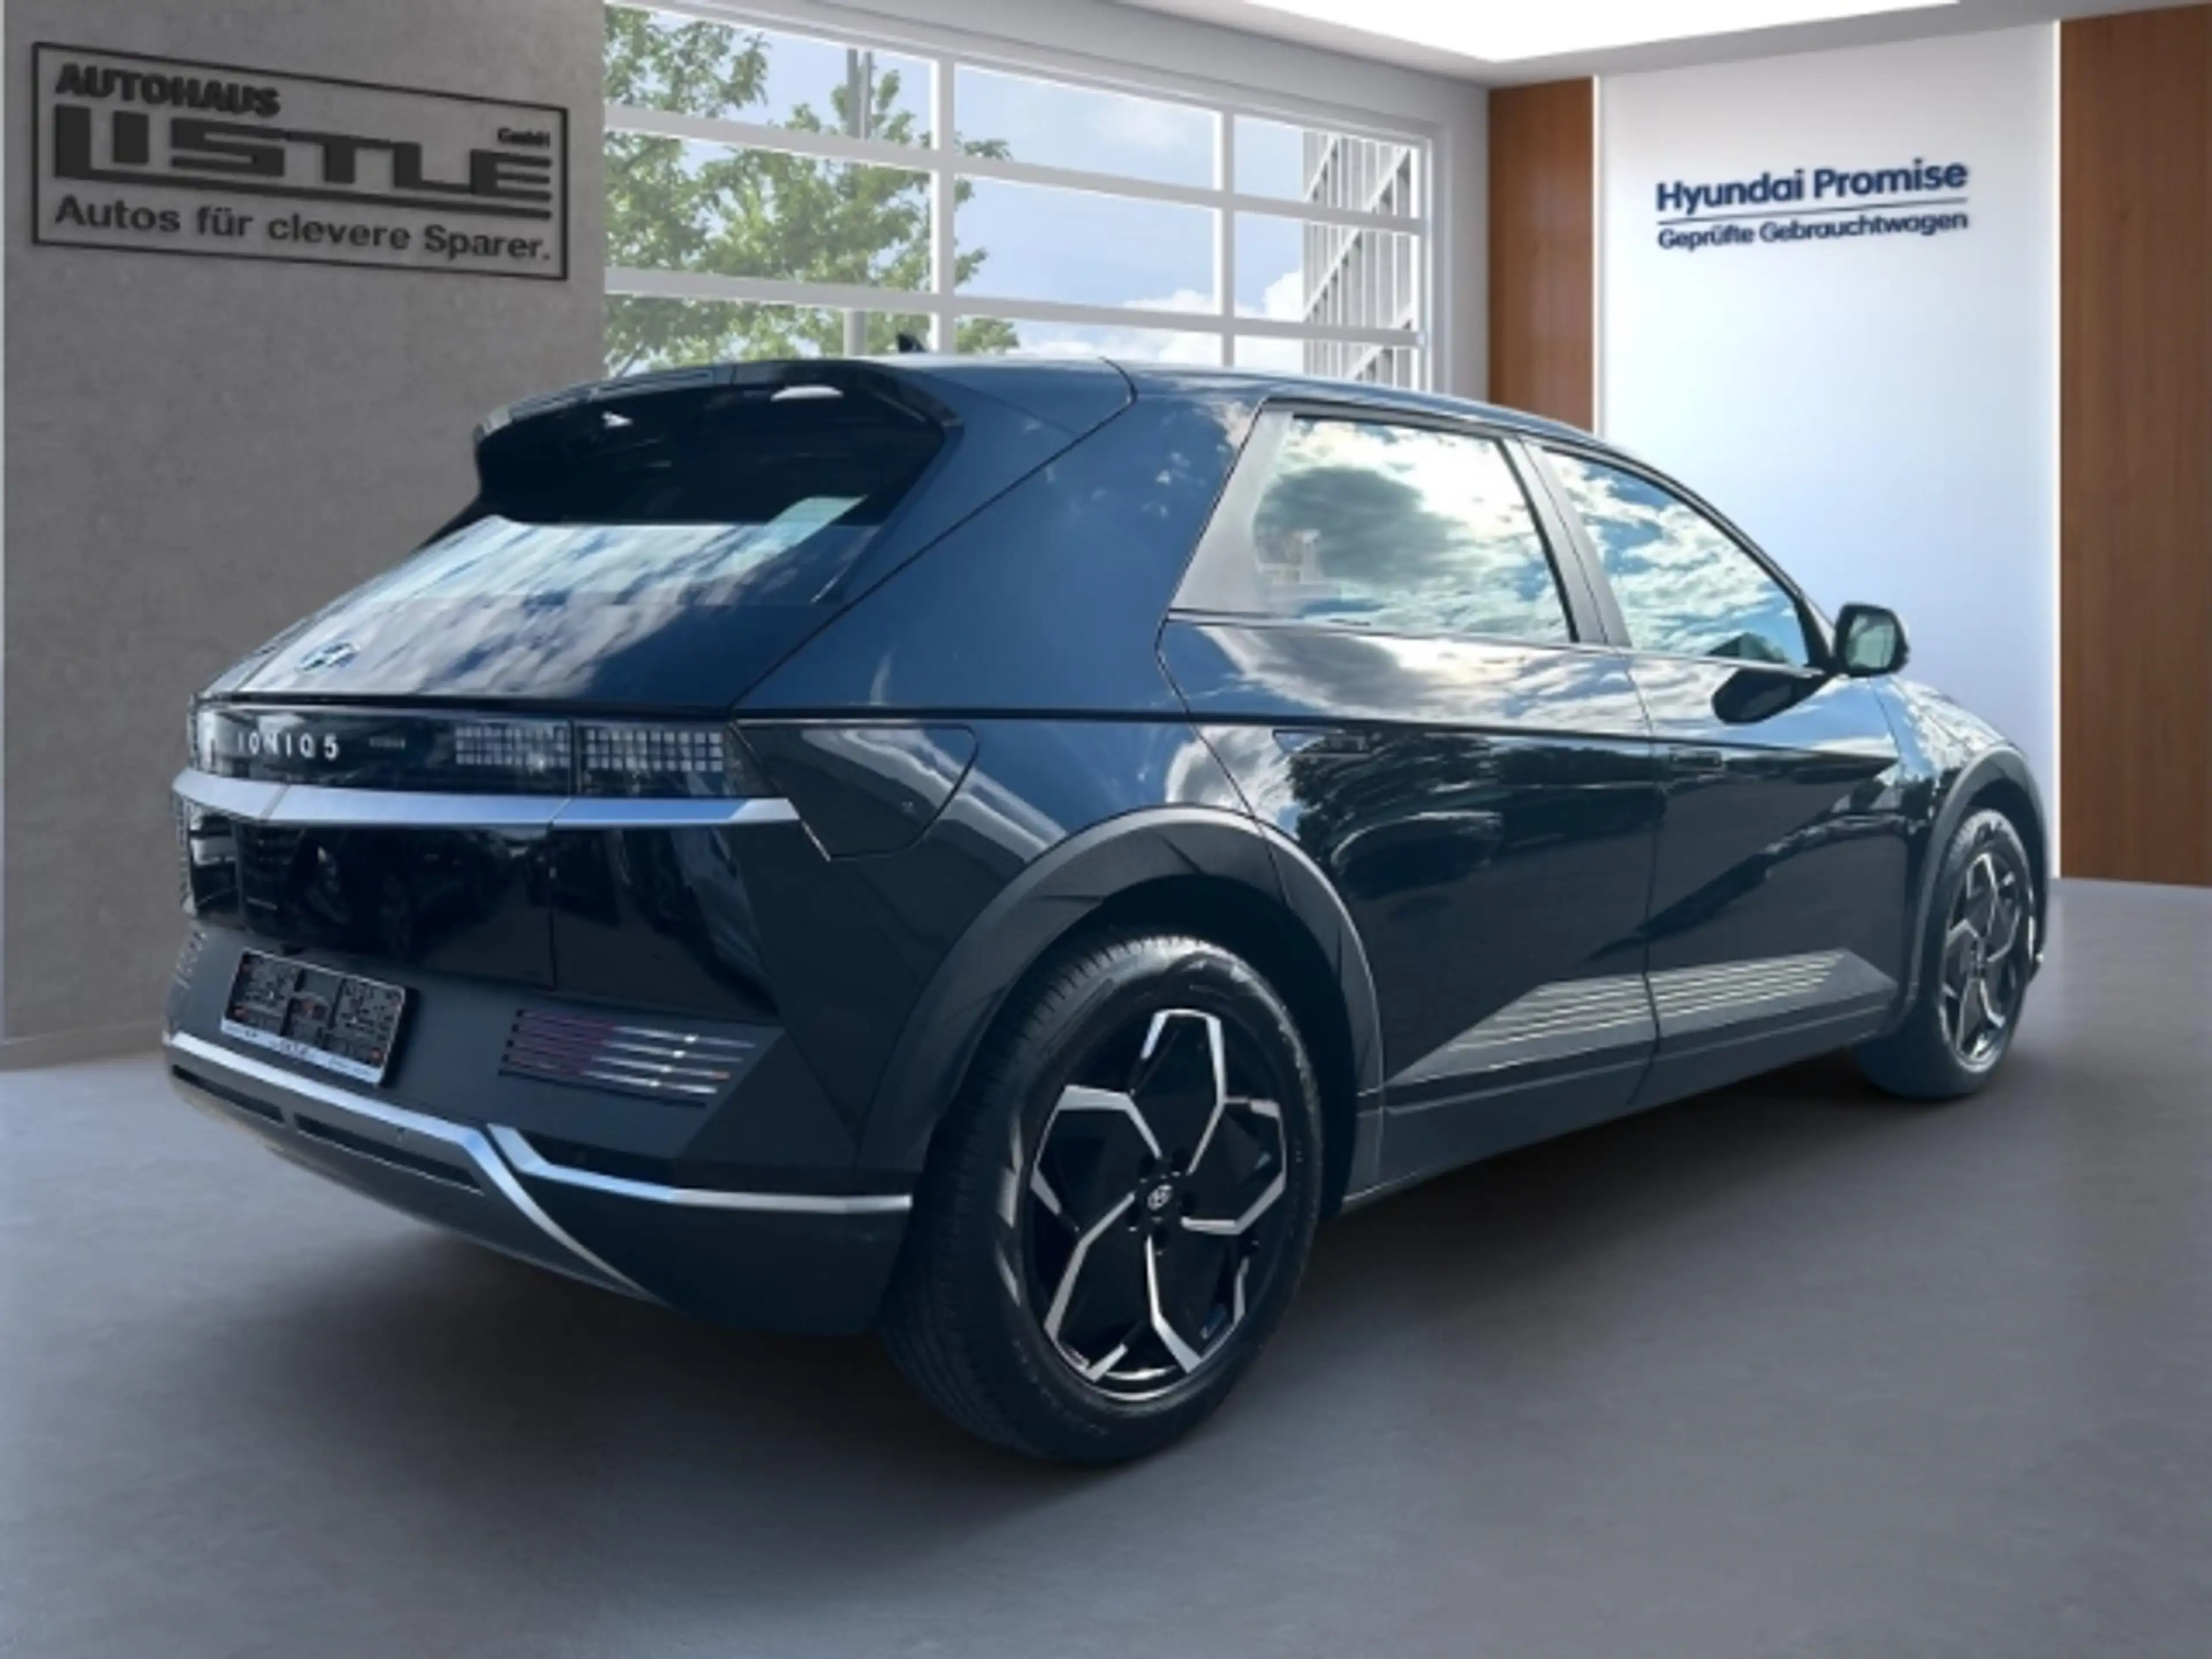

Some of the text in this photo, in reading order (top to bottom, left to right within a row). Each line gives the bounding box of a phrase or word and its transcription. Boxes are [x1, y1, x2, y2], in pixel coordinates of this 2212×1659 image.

[56, 63, 281, 118] AUTOHAUS
[1657, 158, 1969, 215] Hyundai Promise
[55, 194, 551, 260] Autos für clevere Sparer.
[1658, 211, 1969, 252] Geprüfte Gebrauchtwagen
[324, 732, 340, 762] 5
